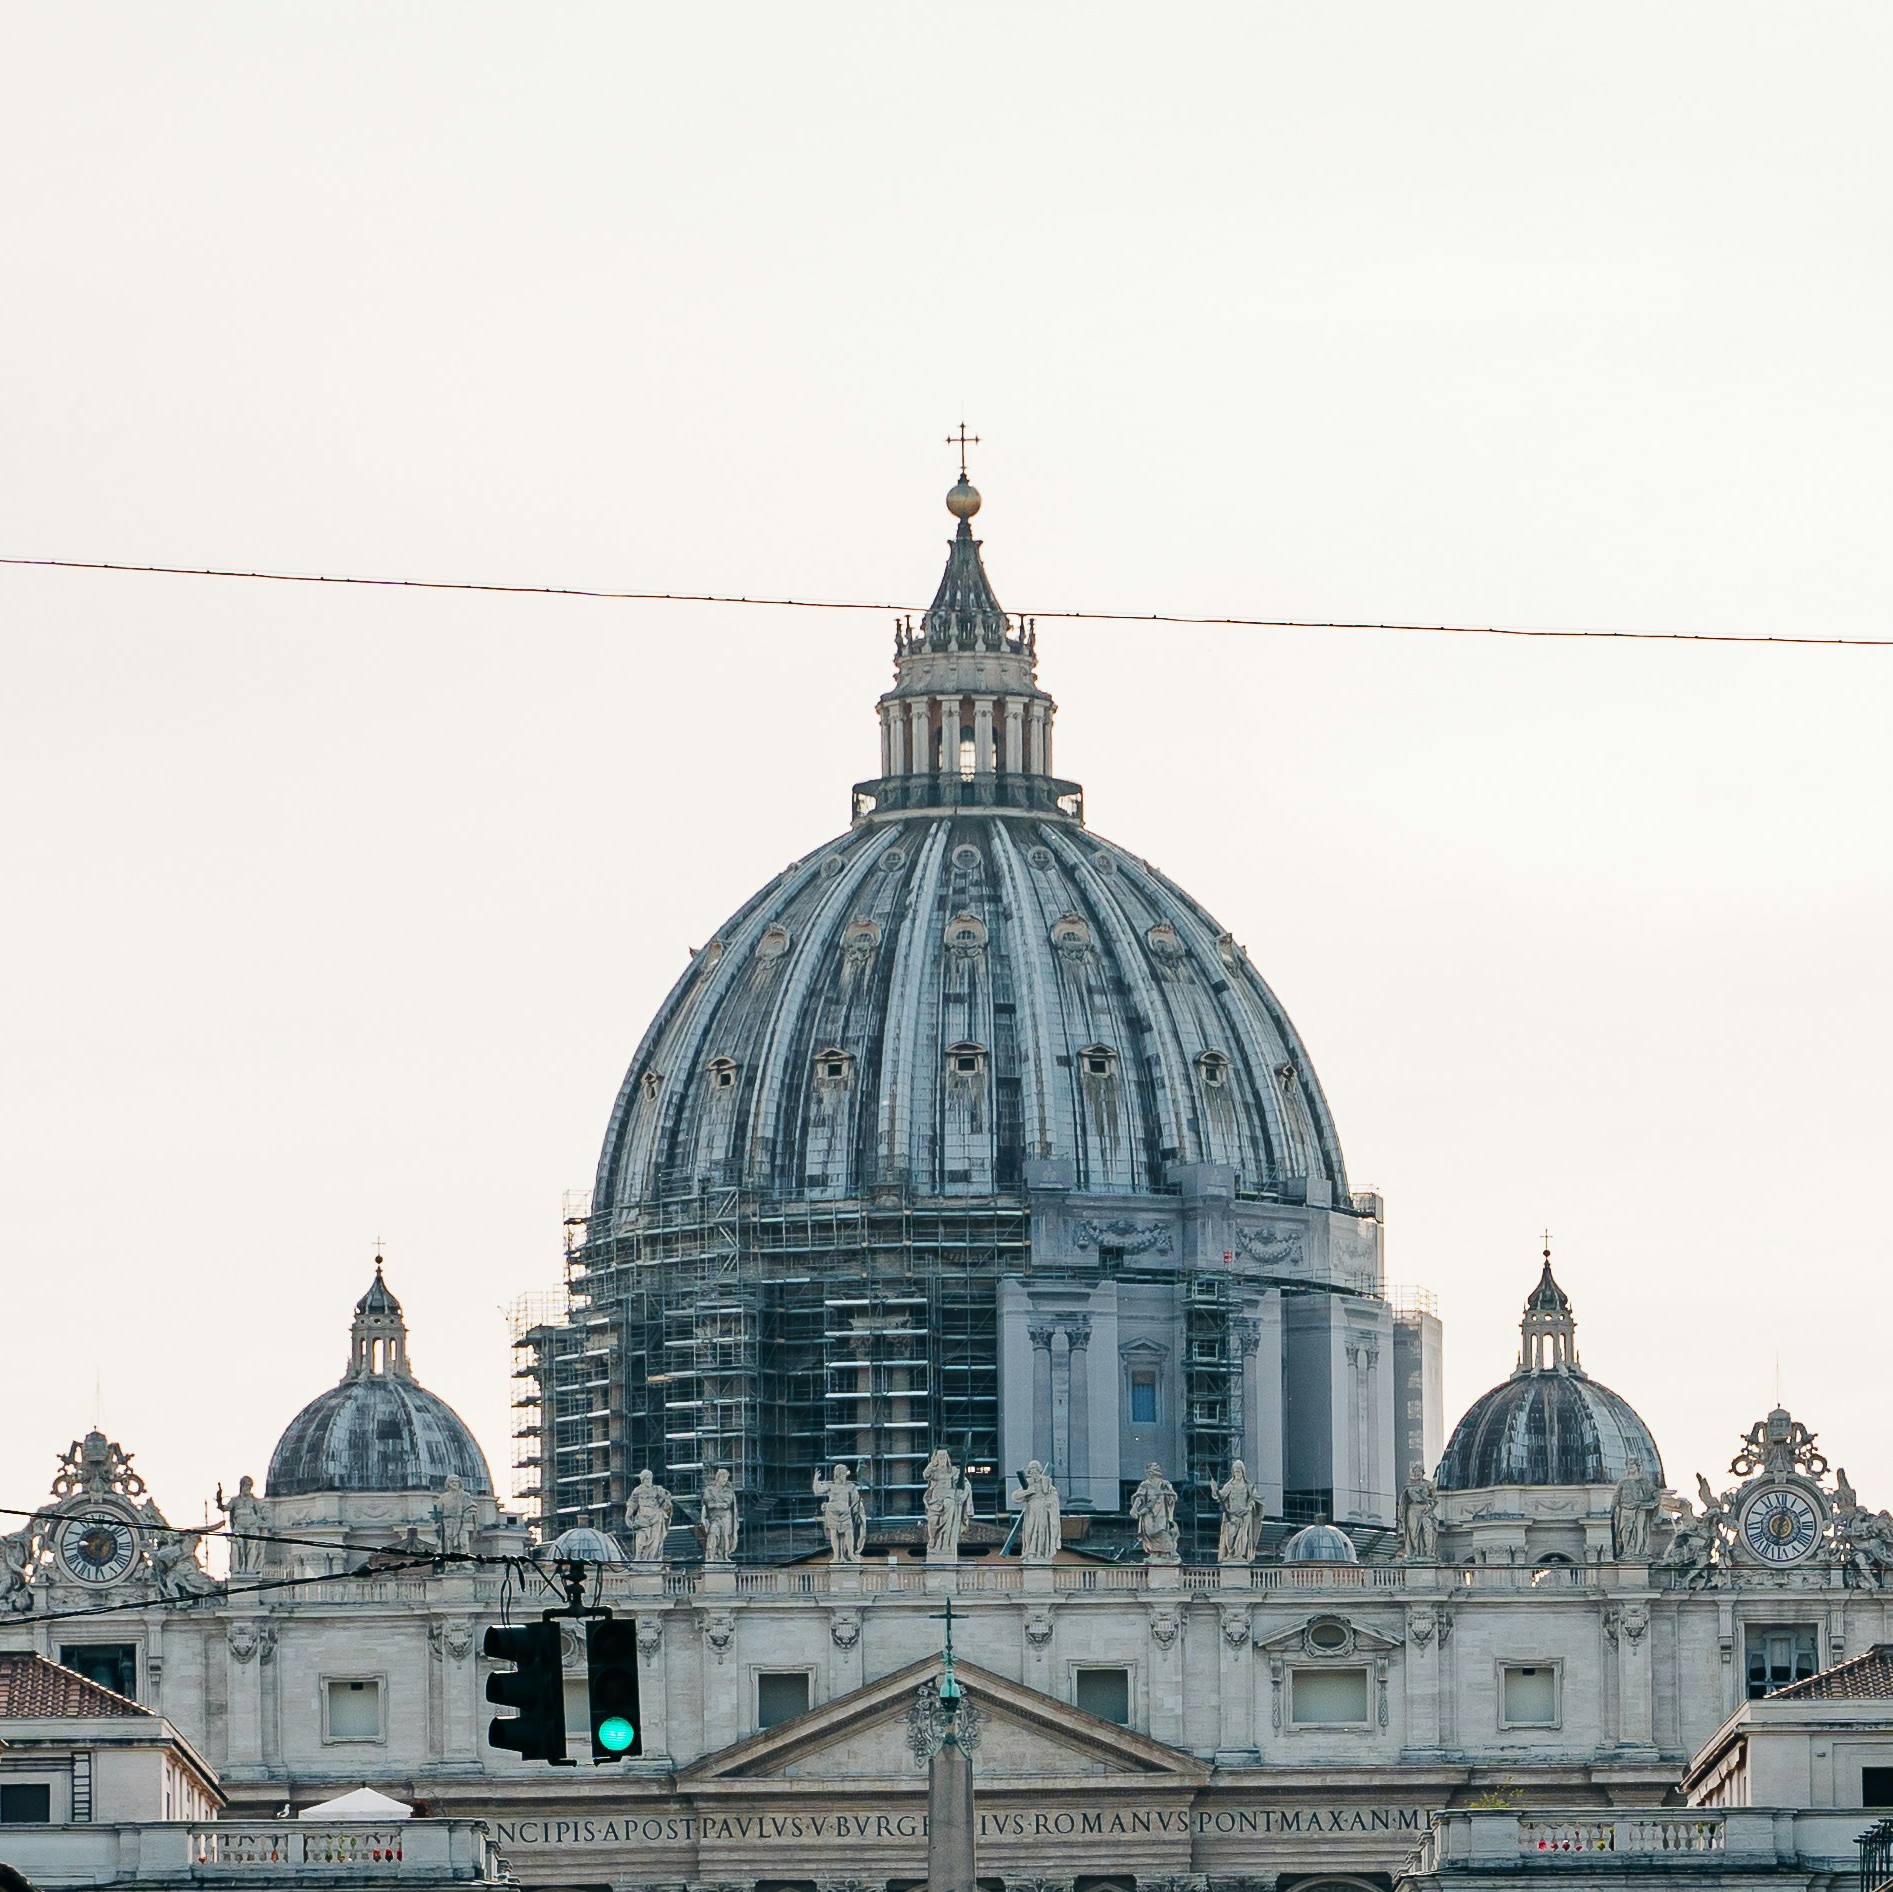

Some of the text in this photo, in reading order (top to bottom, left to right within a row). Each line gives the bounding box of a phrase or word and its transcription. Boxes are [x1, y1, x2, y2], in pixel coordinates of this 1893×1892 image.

[602, 1818, 697, 1841] APOST
[703, 1816, 803, 1839] PAVLVS
[811, 1815, 826, 1838] V
[1034, 1811, 1189, 1835] ROMANVS
[1198, 1811, 1276, 1832] PONT
[1280, 1810, 1344, 1831] MAX
[1350, 1809, 1389, 1831] AN
